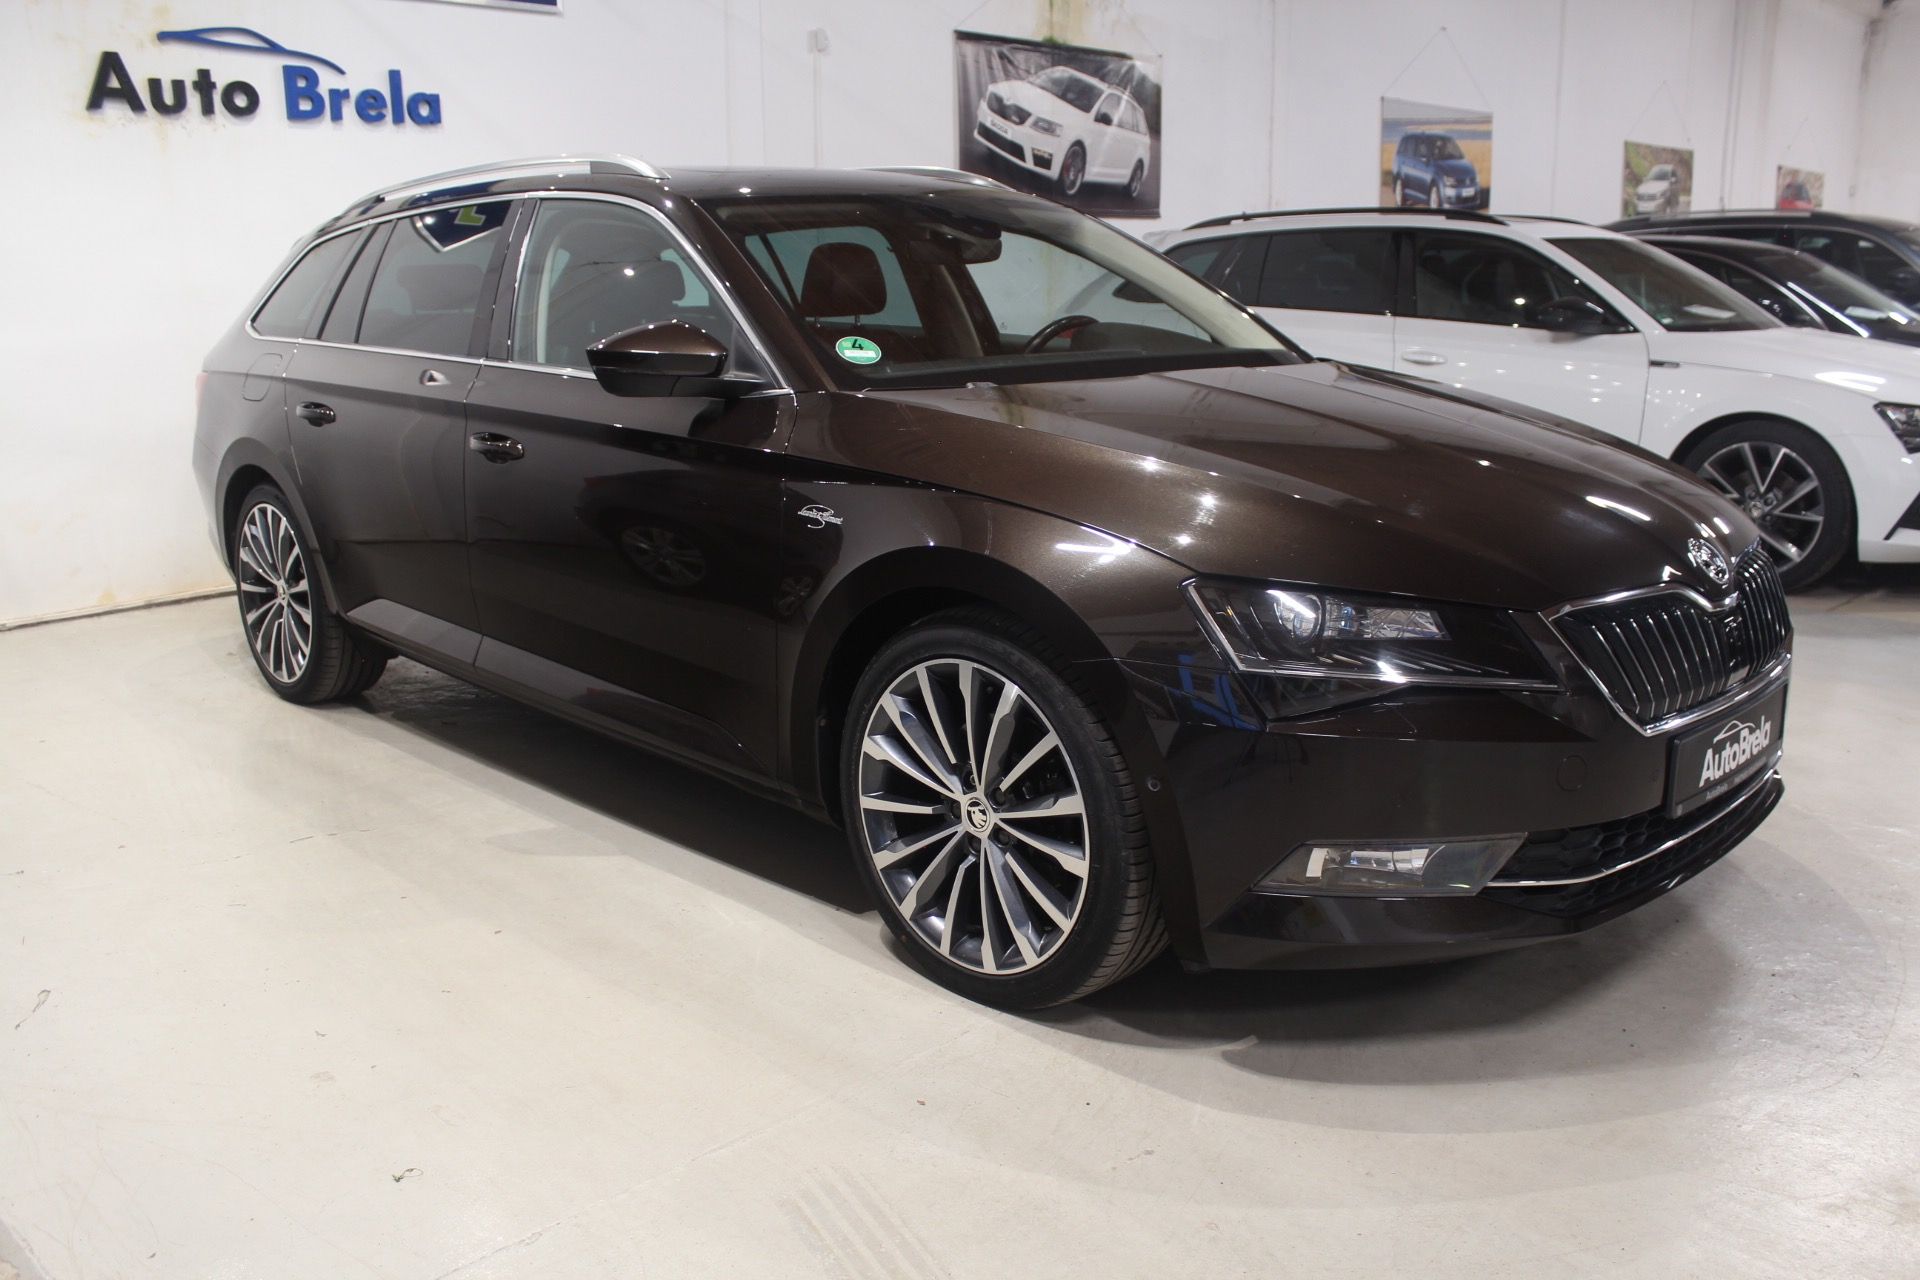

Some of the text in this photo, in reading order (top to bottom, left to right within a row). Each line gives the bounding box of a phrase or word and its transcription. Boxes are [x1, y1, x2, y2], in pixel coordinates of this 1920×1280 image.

[86, 51, 442, 125] Auto Brela
[851, 338, 864, 350] 4
[1699, 715, 1771, 788] AutoBrela
